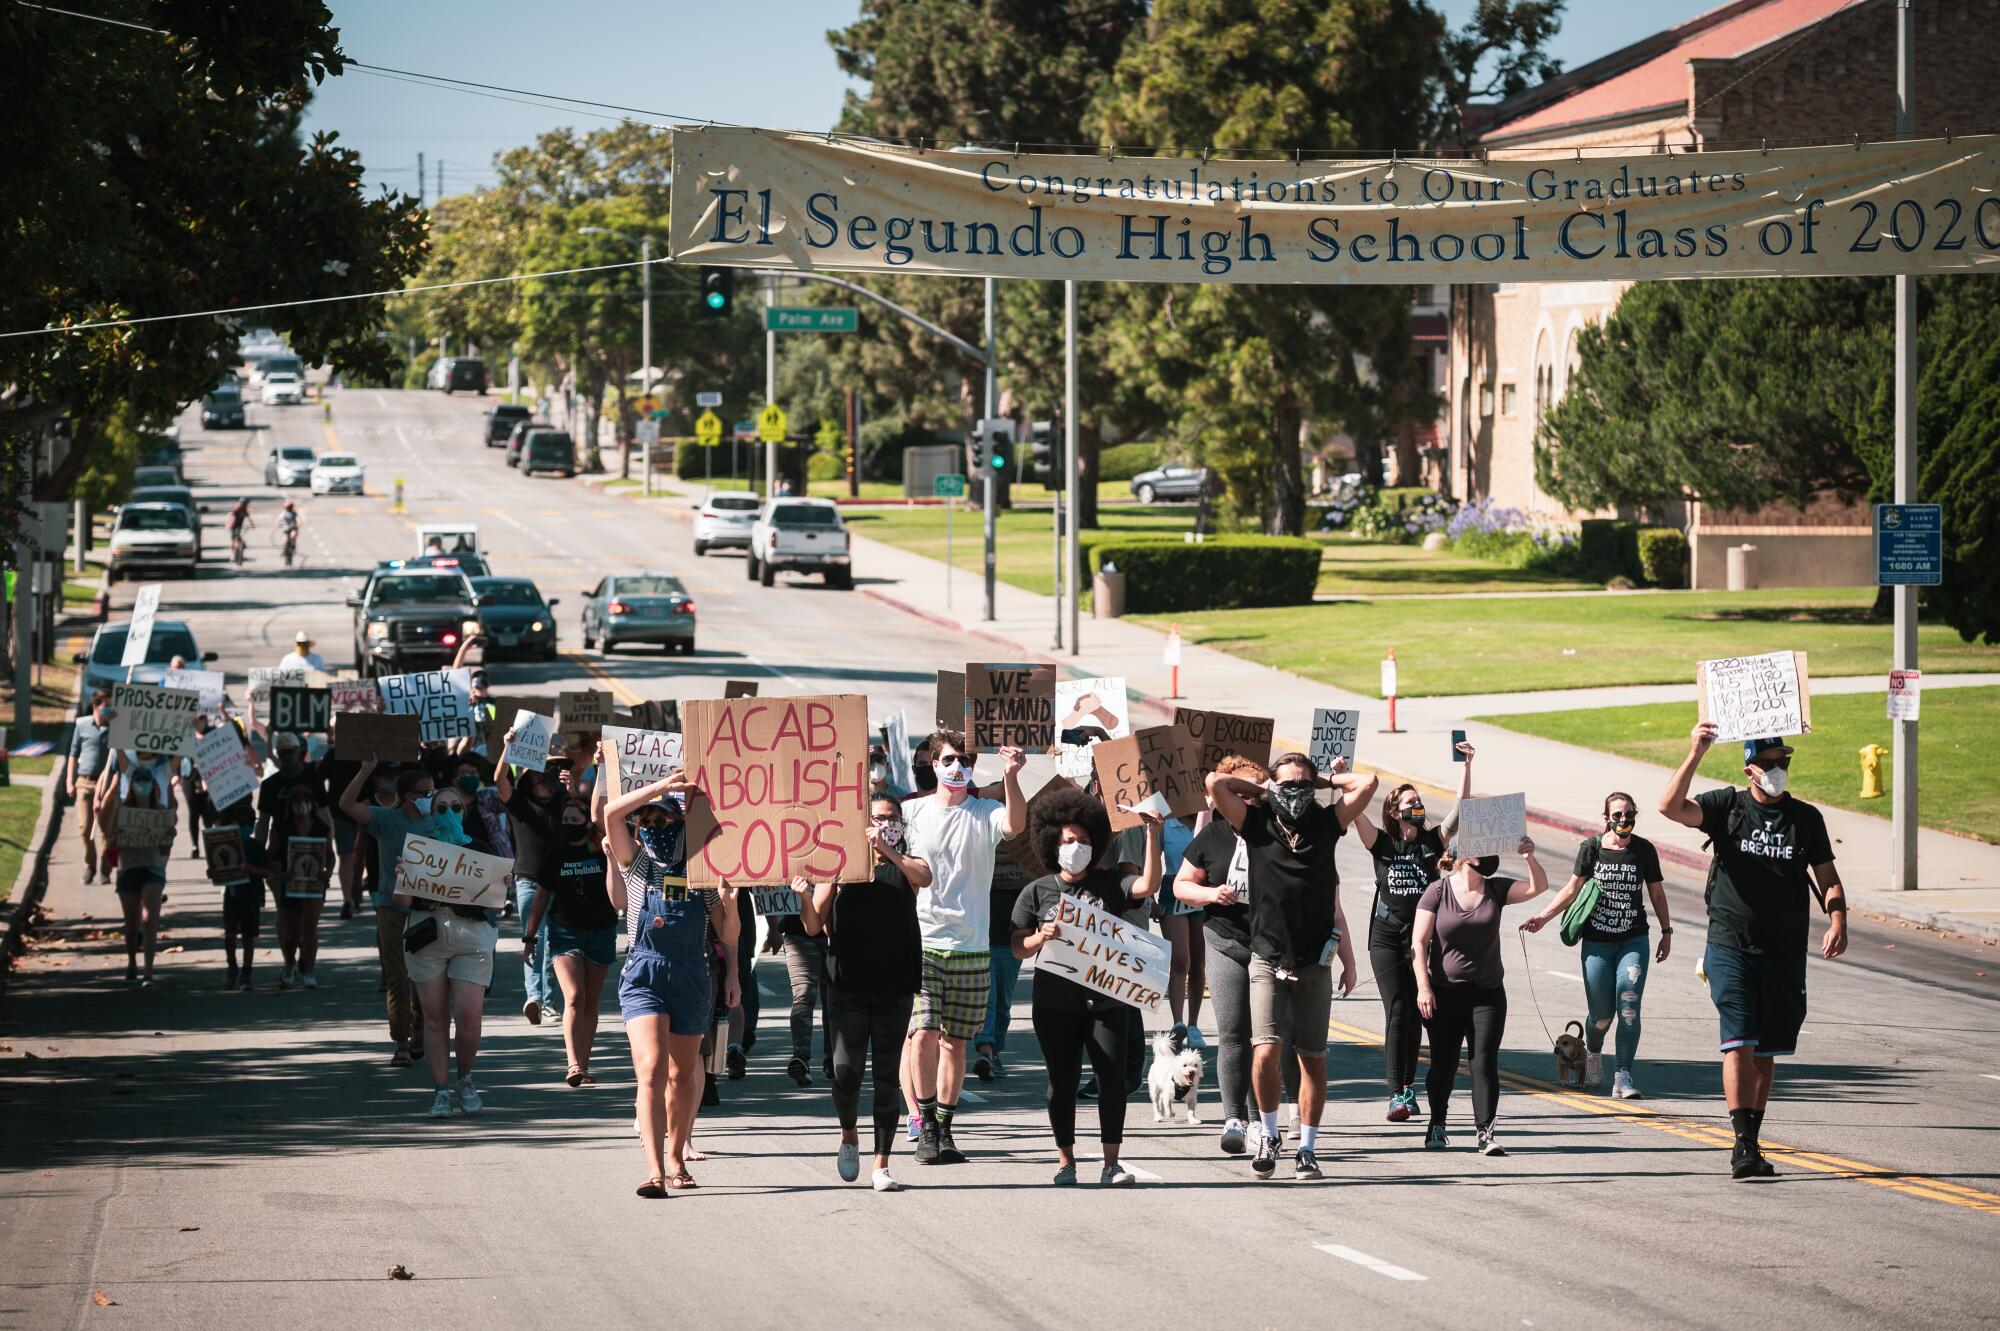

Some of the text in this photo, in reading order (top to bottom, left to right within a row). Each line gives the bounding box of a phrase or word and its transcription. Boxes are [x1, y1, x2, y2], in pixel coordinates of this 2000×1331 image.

[981, 160, 1746, 204] Congratulations to Our Graduates
[709, 188, 2000, 275] El Segundo High School Class of 2020
[779, 312, 844, 325] Palm Ave
[1889, 562, 1931, 570] 1680 AM
[1710, 659, 1740, 671] 2020
[388, 672, 452, 699] BLACK
[989, 671, 1032, 695] WE
[1752, 671, 1782, 686] 1980
[1891, 679, 1904, 688] NO
[114, 687, 200, 712] PROSECUTE
[1754, 681, 1793, 700] 1992
[276, 691, 330, 729] BLM
[390, 695, 458, 720] LIVES
[974, 697, 1052, 722] DEMAND
[1753, 698, 1787, 713] 2001
[419, 717, 471, 741] TTER
[1175, 711, 1272, 744] NO EXCUSES
[1325, 711, 1347, 724] NO
[705, 702, 838, 757] ACAB
[974, 723, 1056, 747] REFORM
[1312, 727, 1355, 741] JUSTICE
[135, 733, 183, 751] COPS
[1323, 743, 1342, 755] NO
[510, 744, 546, 764] BREATHE
[685, 759, 864, 814] ABOLISH
[1461, 796, 1522, 820] BLACK
[1468, 815, 1519, 838] LIVES
[1751, 829, 1784, 845] CAN'T
[1764, 821, 1772, 831] I
[405, 839, 484, 879] Say his
[703, 818, 848, 880] COPS
[1741, 839, 1793, 859] BREATHE
[1600, 864, 1618, 872] you
[1621, 864, 1637, 872] are
[1627, 872, 1637, 882] in
[403, 871, 465, 899] NAME
[1388, 878, 1419, 888] Korey
[754, 892, 792, 915] BLACK
[1608, 899, 1631, 909] have
[1625, 909, 1637, 917] the
[1057, 899, 1125, 944] BLACK
[1077, 937, 1146, 973] LIVES
[1085, 965, 1160, 1009] MATTER
